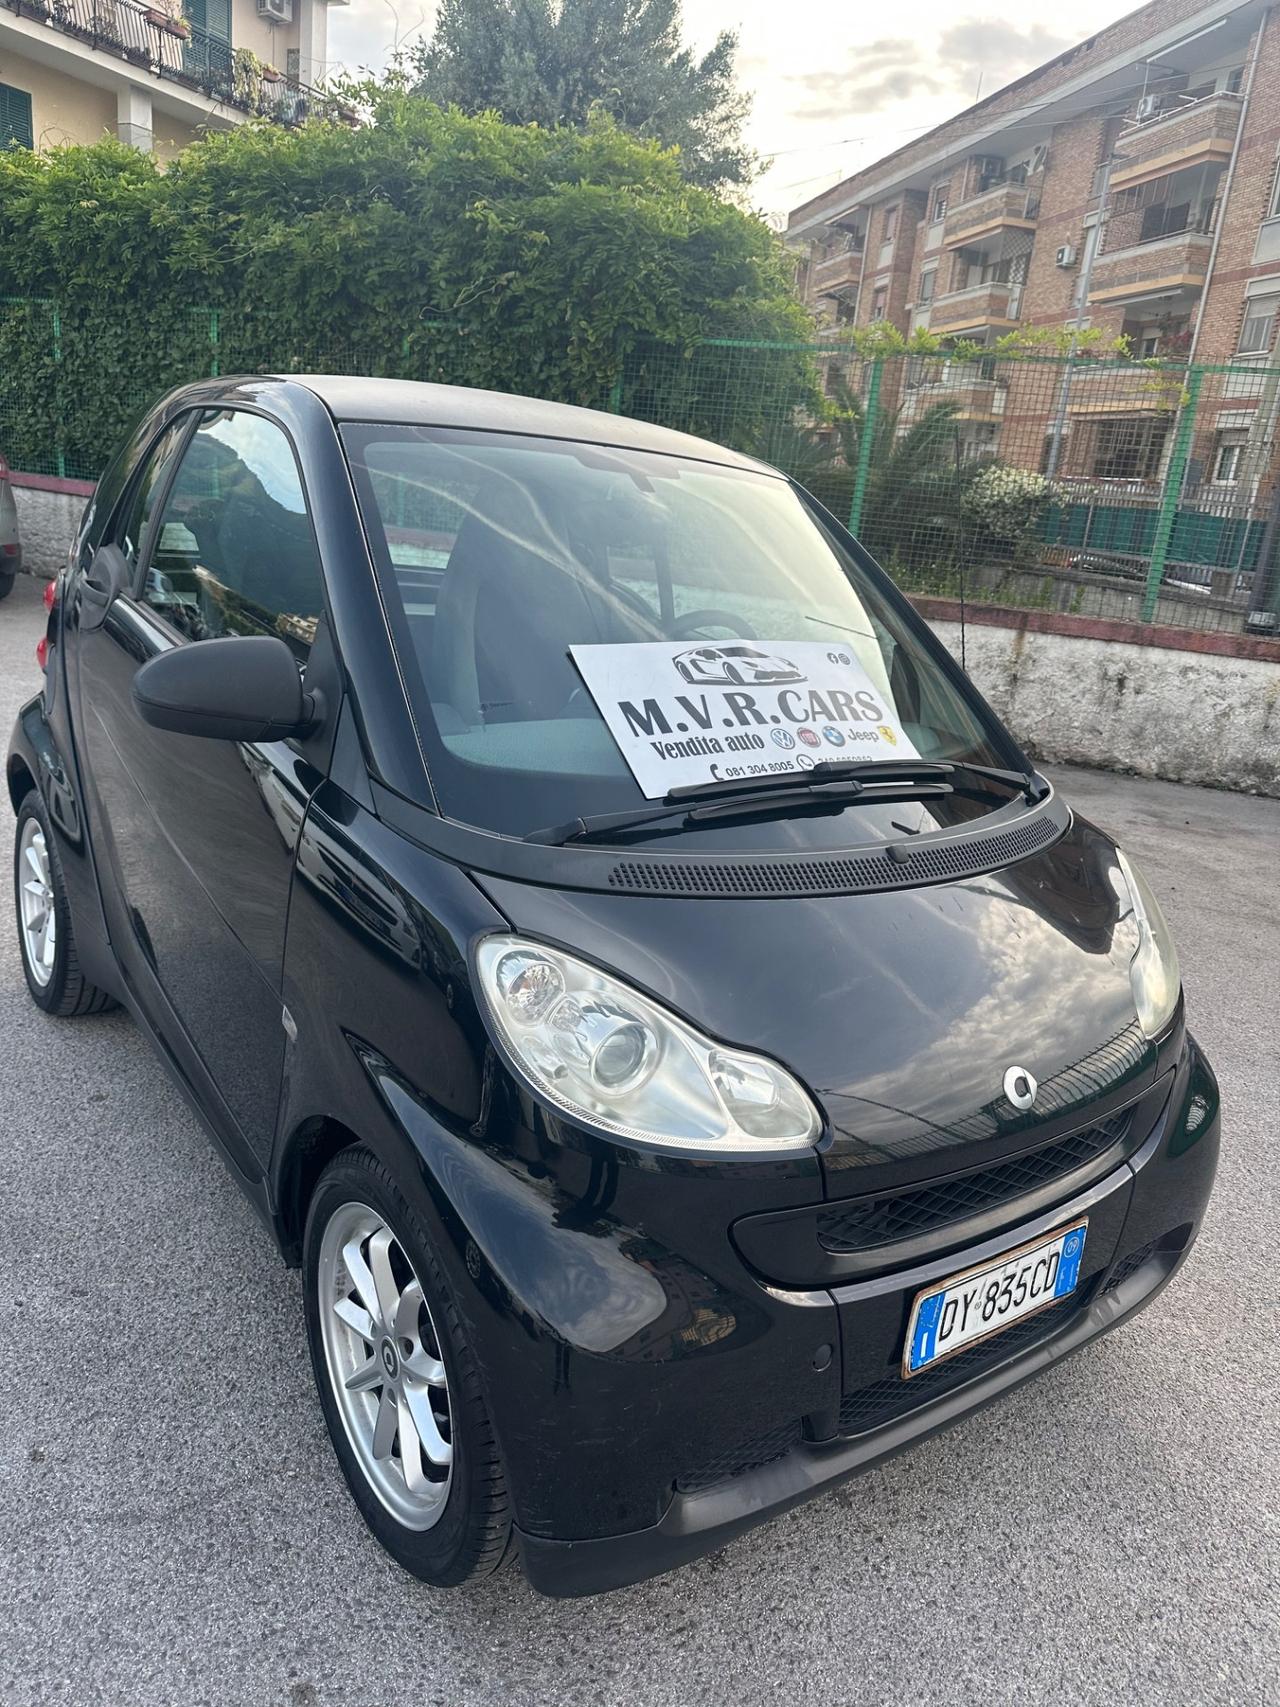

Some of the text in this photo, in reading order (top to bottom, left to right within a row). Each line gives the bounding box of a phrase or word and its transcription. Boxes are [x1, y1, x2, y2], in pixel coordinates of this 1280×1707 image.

[848, 728, 879, 742] Jeep
[650, 732, 765, 761] Vendita auto
[725, 761, 794, 777] 081 304 8005
